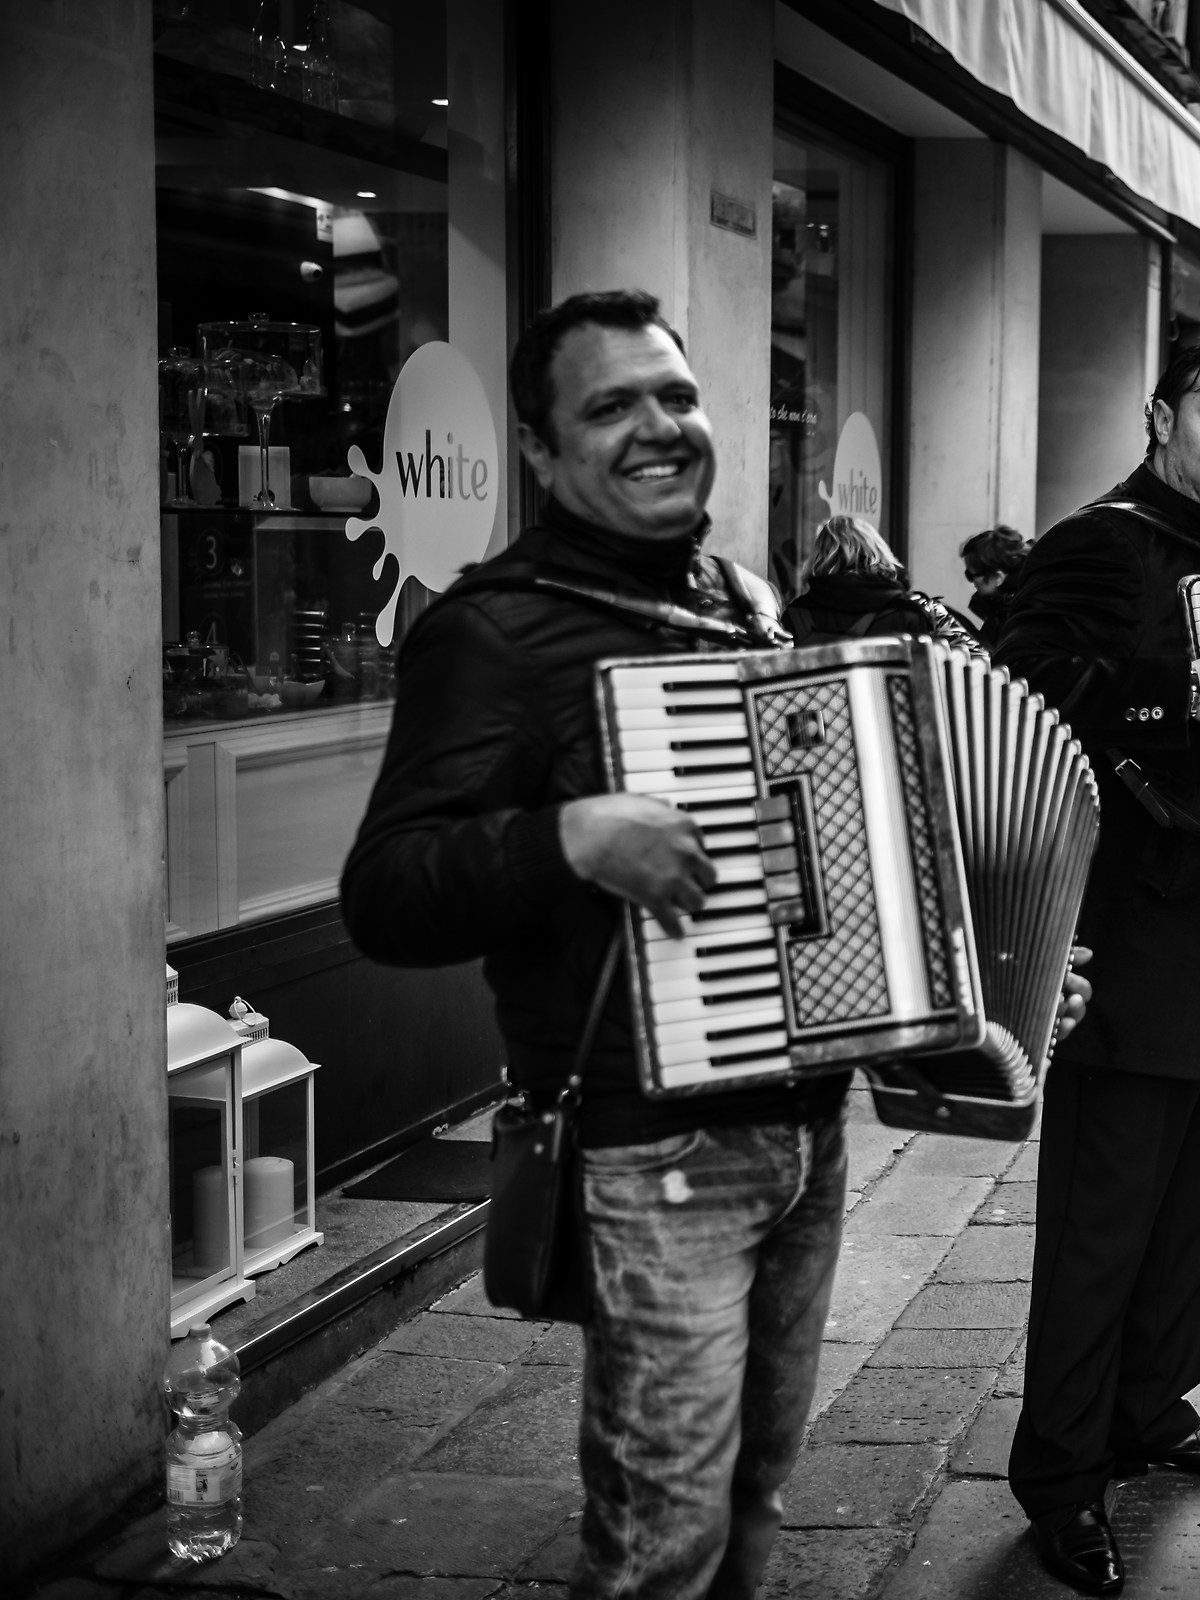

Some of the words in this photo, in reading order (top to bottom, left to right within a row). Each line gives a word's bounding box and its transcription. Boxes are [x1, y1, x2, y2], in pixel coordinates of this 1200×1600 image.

[396, 429, 488, 501] white
[838, 468, 877, 514] white
[205, 535, 218, 570] 3
